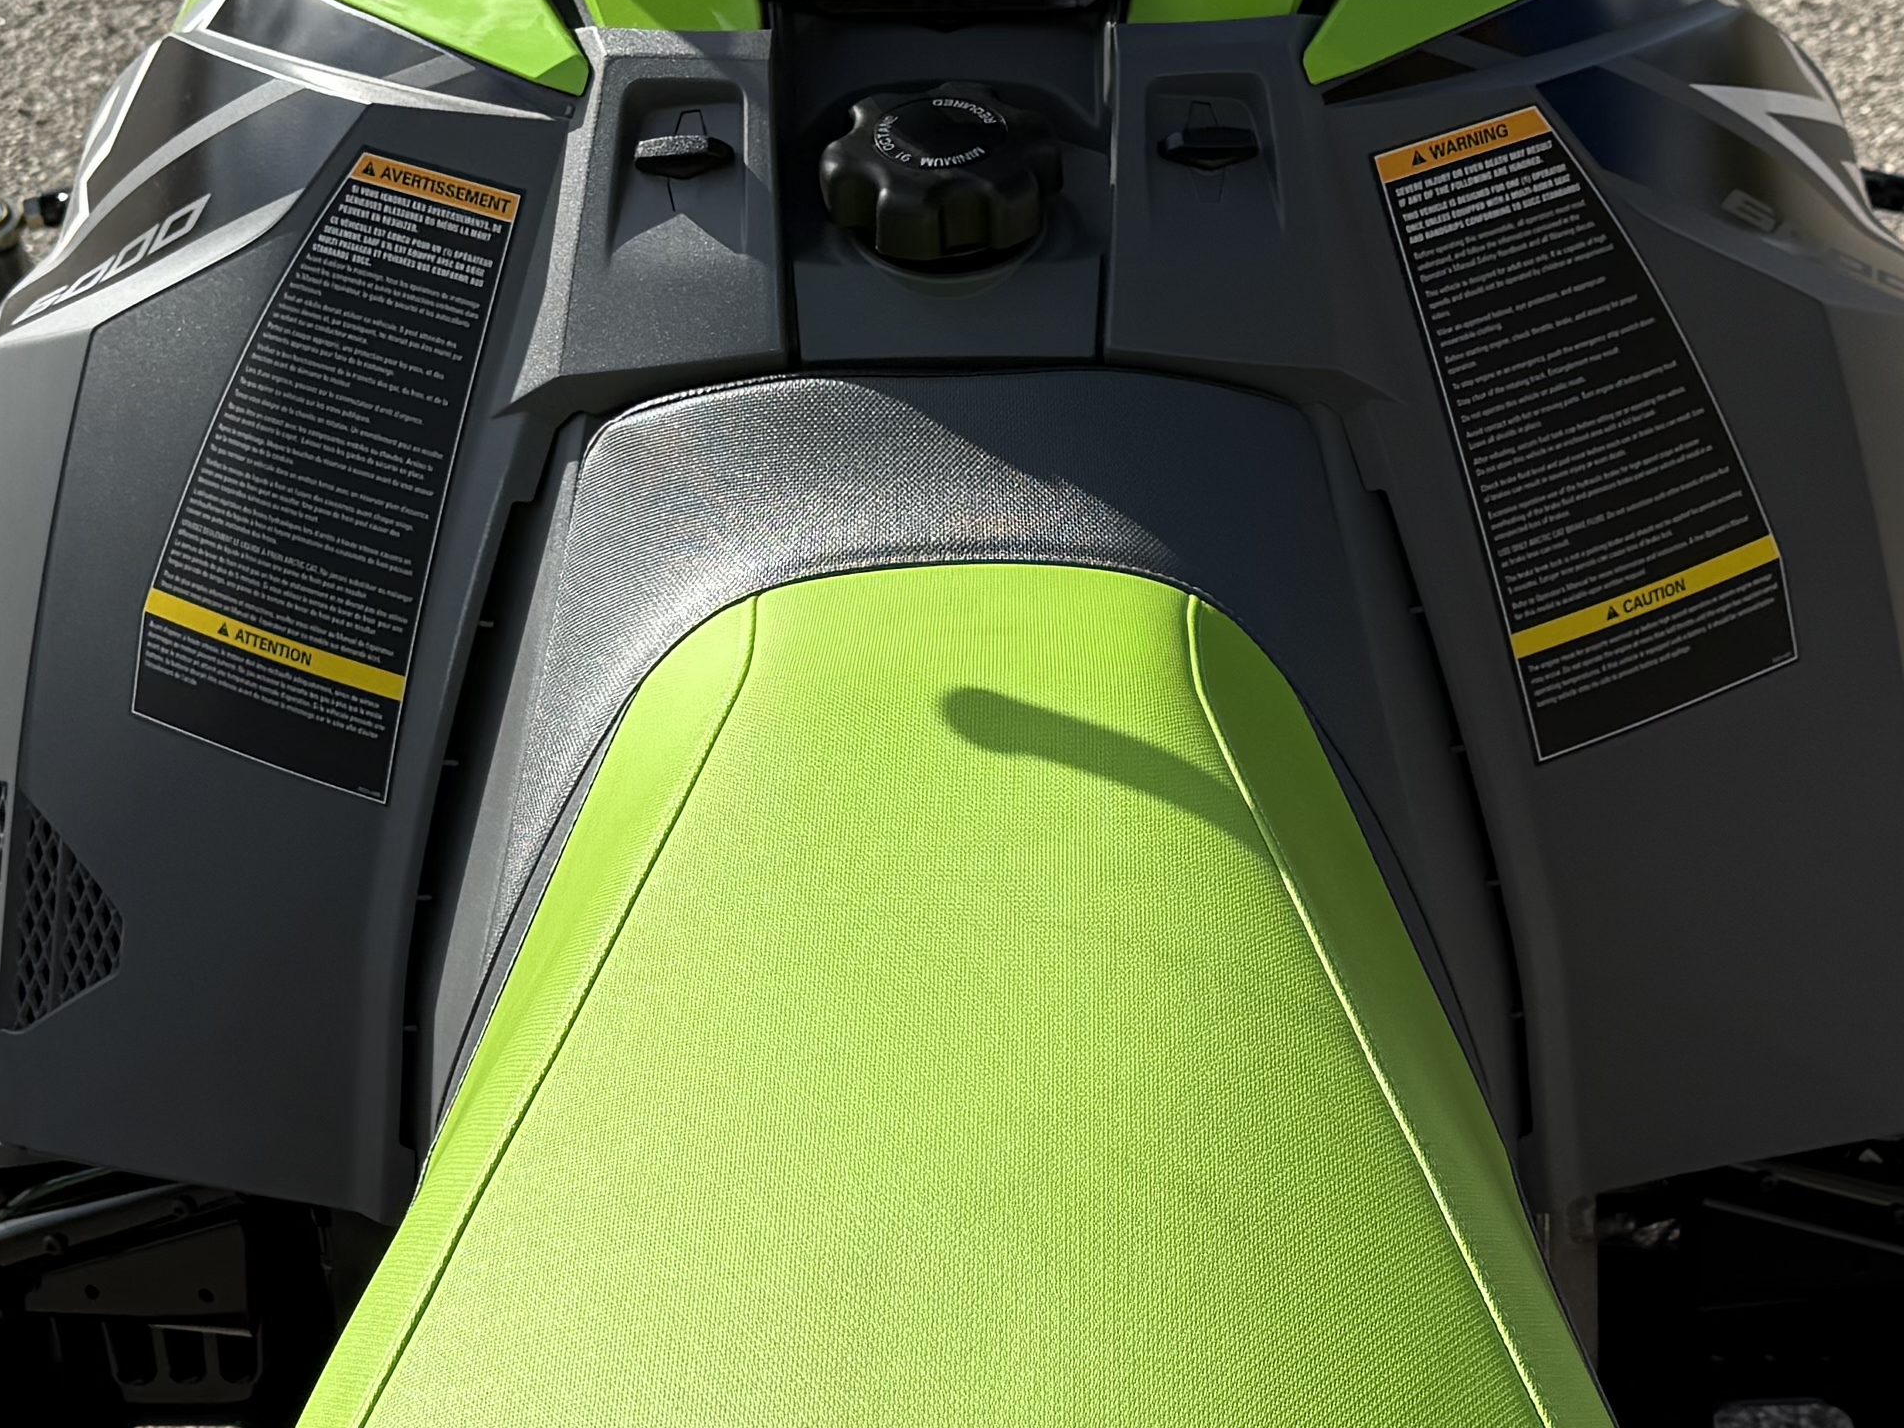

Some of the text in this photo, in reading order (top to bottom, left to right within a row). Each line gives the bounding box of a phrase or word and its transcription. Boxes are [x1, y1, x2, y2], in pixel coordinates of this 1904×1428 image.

[895, 151, 912, 163] 91
[1429, 123, 1510, 161] WARNING
[380, 165, 512, 214] AVERTISSEMENT
[1622, 578, 1687, 615] CAUTION
[234, 627, 313, 667] ATTENTION
